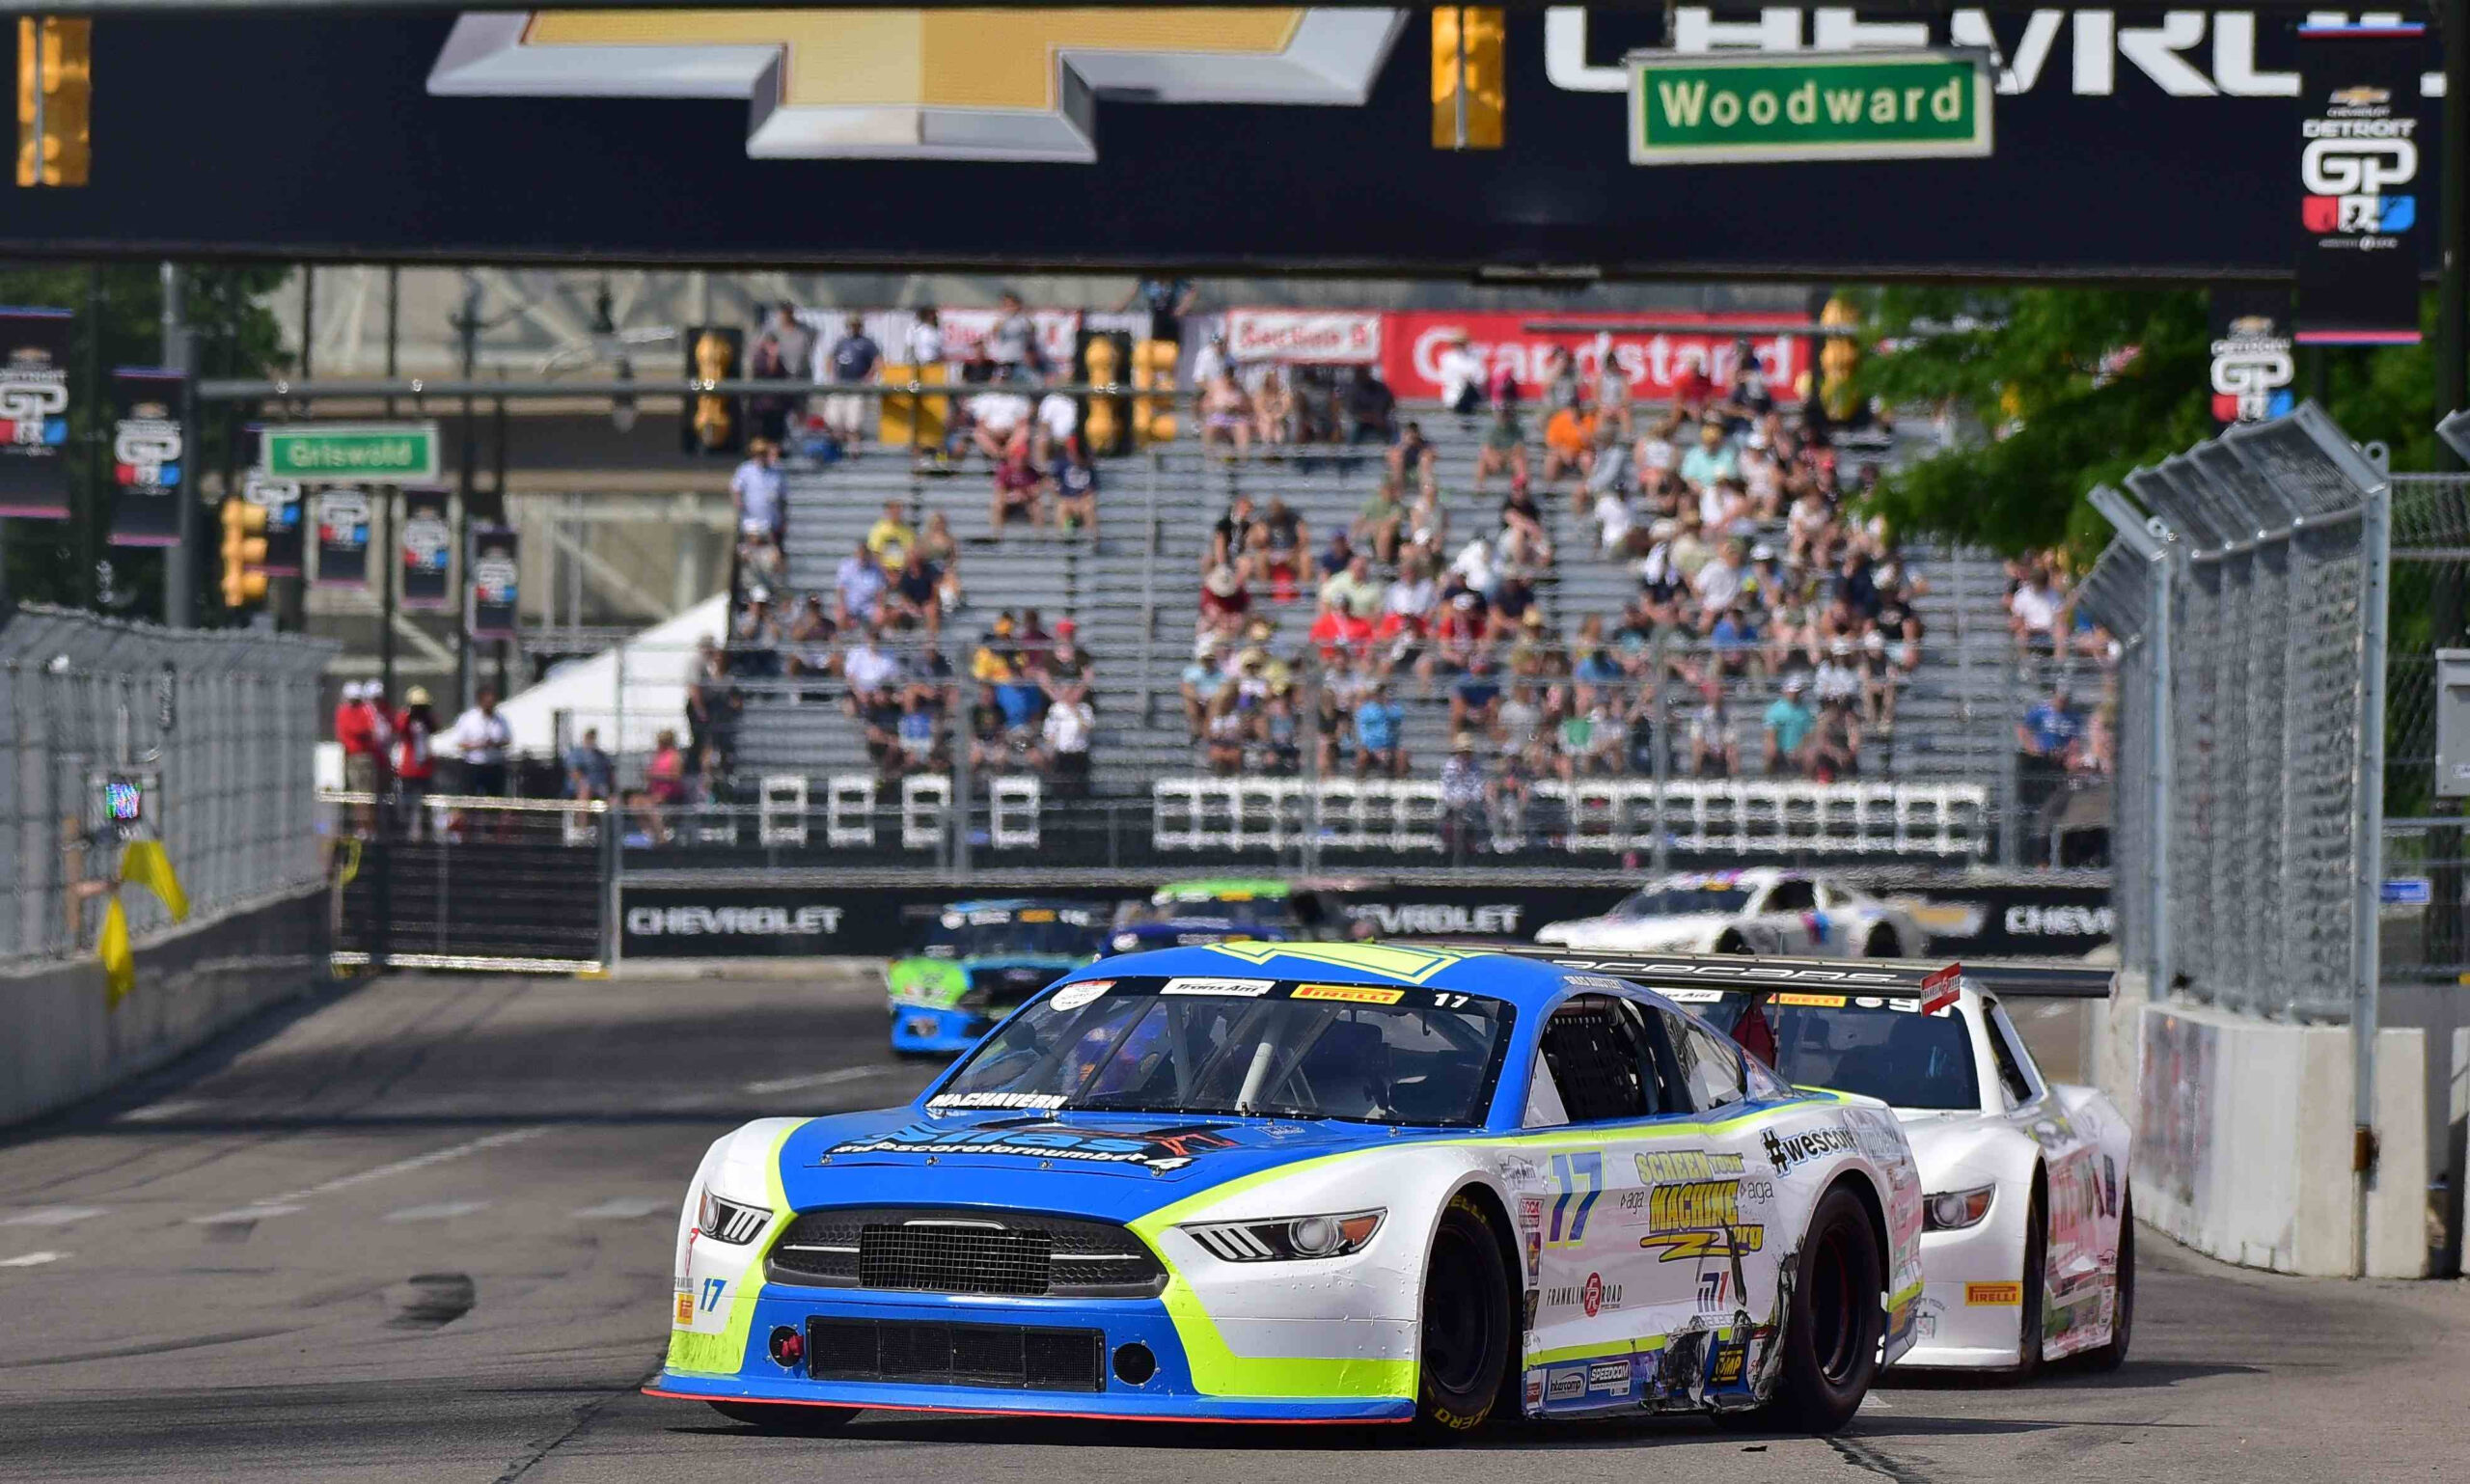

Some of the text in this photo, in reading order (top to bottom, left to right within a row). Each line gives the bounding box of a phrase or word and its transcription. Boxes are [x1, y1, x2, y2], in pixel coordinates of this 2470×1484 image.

[1659, 79, 1962, 127] Woodward
[2302, 119, 2418, 138] DETROIT
[2302, 138, 2419, 196] GP
[2210, 351, 2294, 397] GP
[289, 440, 412, 467] Griswold
[627, 905, 845, 935] CHEVROLET
[1299, 986, 1395, 1003] PIRELLI
[1434, 992, 1469, 1008] 17
[926, 1092, 1068, 1110] MACHAVERN
[1634, 1149, 1713, 1185] SCREEN
[1547, 1149, 1605, 1247] 17
[1624, 1191, 1645, 1215] aga
[1747, 1181, 1774, 1204] aga
[1649, 1179, 1740, 1233] MACHINE
[700, 1278, 727, 1312] 17
[1547, 1286, 1583, 1306] FRANKLIN
[1602, 1284, 1622, 1303] ROAD
[1968, 1285, 2017, 1303] PIRELLI
[1590, 1363, 1629, 1382] SPEEDCOM
[1550, 1376, 1582, 1396] Intercomp
